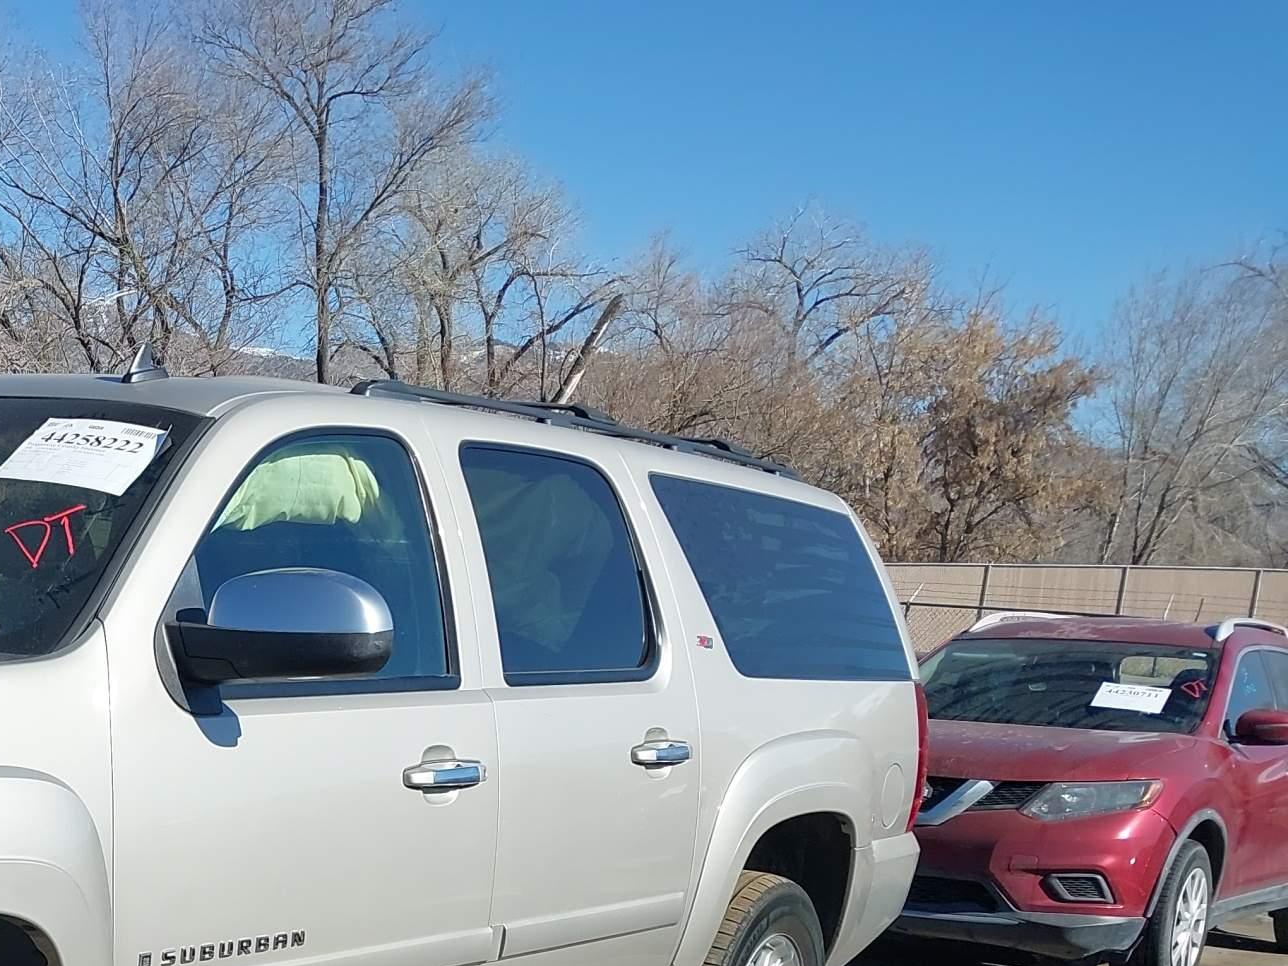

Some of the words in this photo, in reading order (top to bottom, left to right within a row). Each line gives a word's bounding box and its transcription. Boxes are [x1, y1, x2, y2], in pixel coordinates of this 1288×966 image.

[41, 432, 144, 453] 44258222
[4, 503, 87, 568] DT
[160, 930, 305, 966] SUBURBAN
